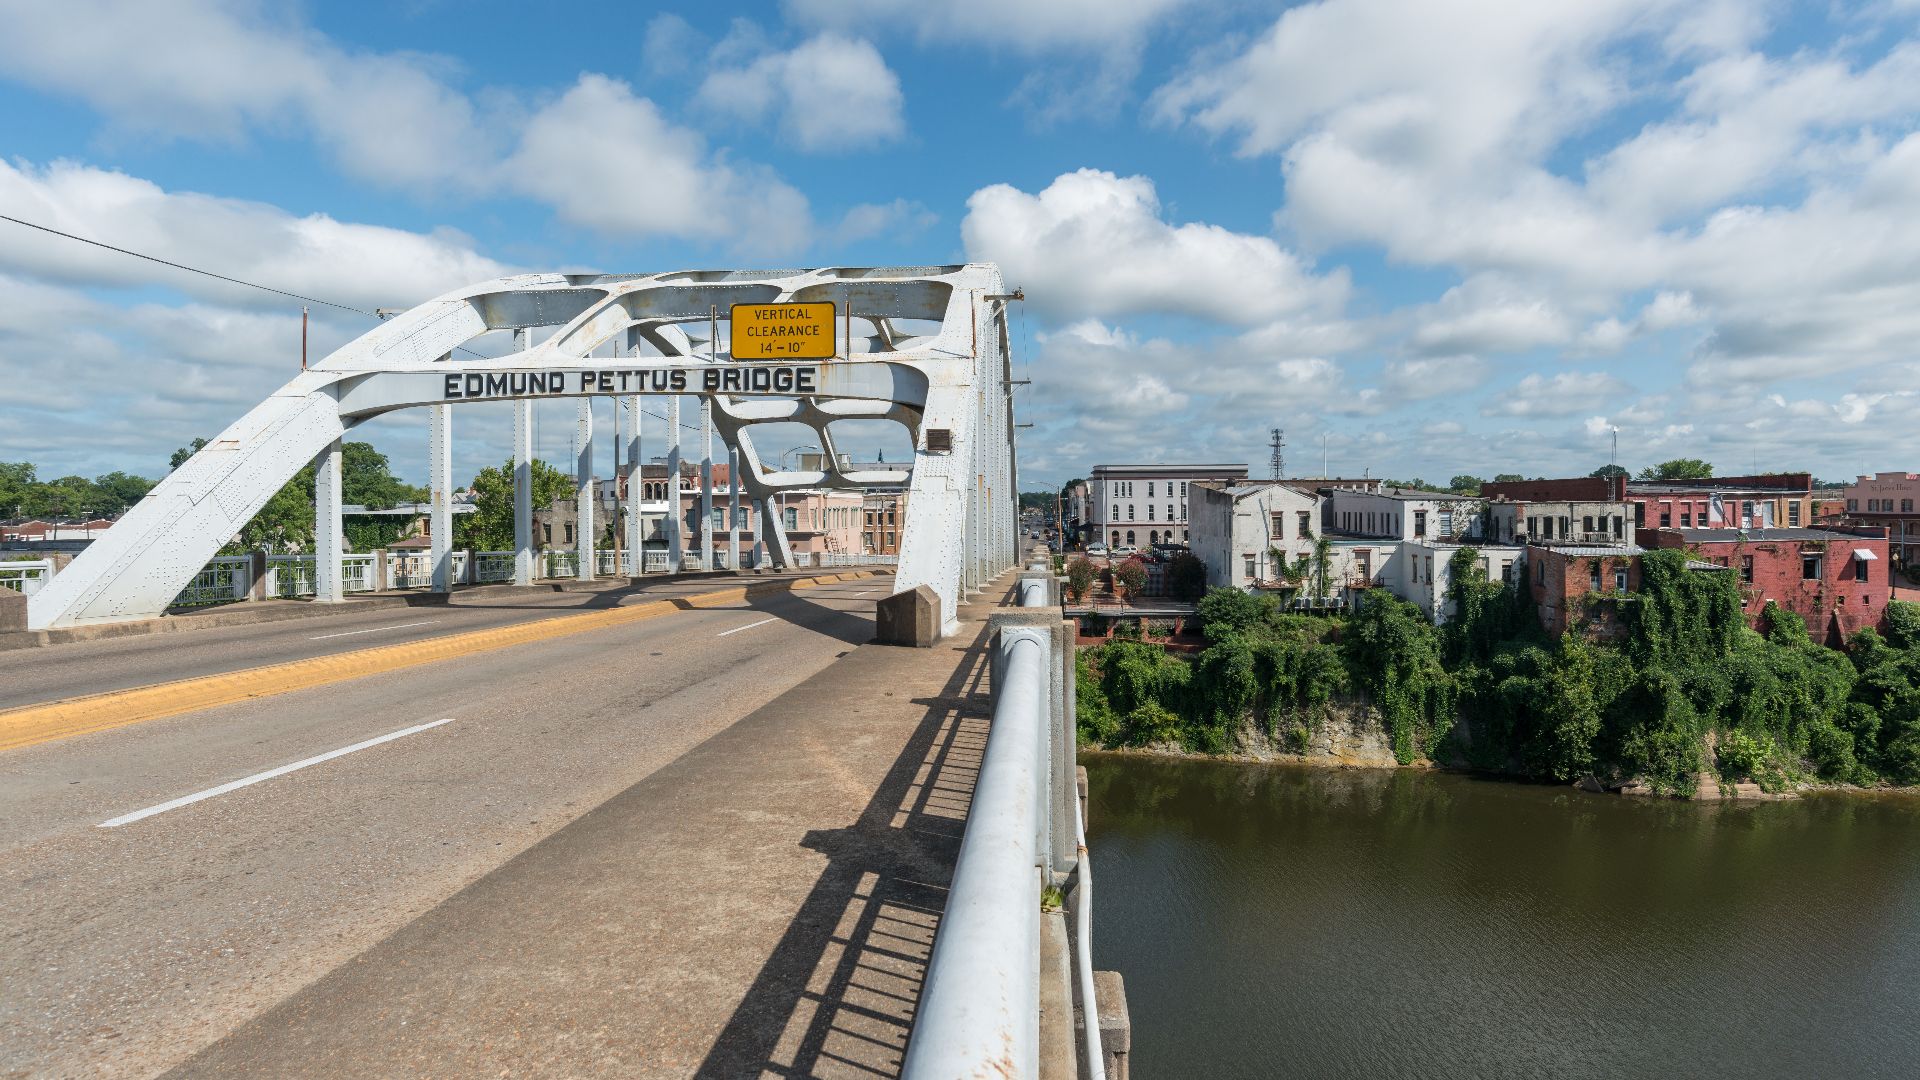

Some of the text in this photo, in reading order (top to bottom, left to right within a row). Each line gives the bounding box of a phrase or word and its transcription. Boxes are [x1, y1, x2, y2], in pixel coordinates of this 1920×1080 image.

[754, 308, 813, 320] VERTICAL
[747, 325, 820, 337] CLEARANCE
[445, 367, 816, 398] EDMUND PETTUS BRIDGE
